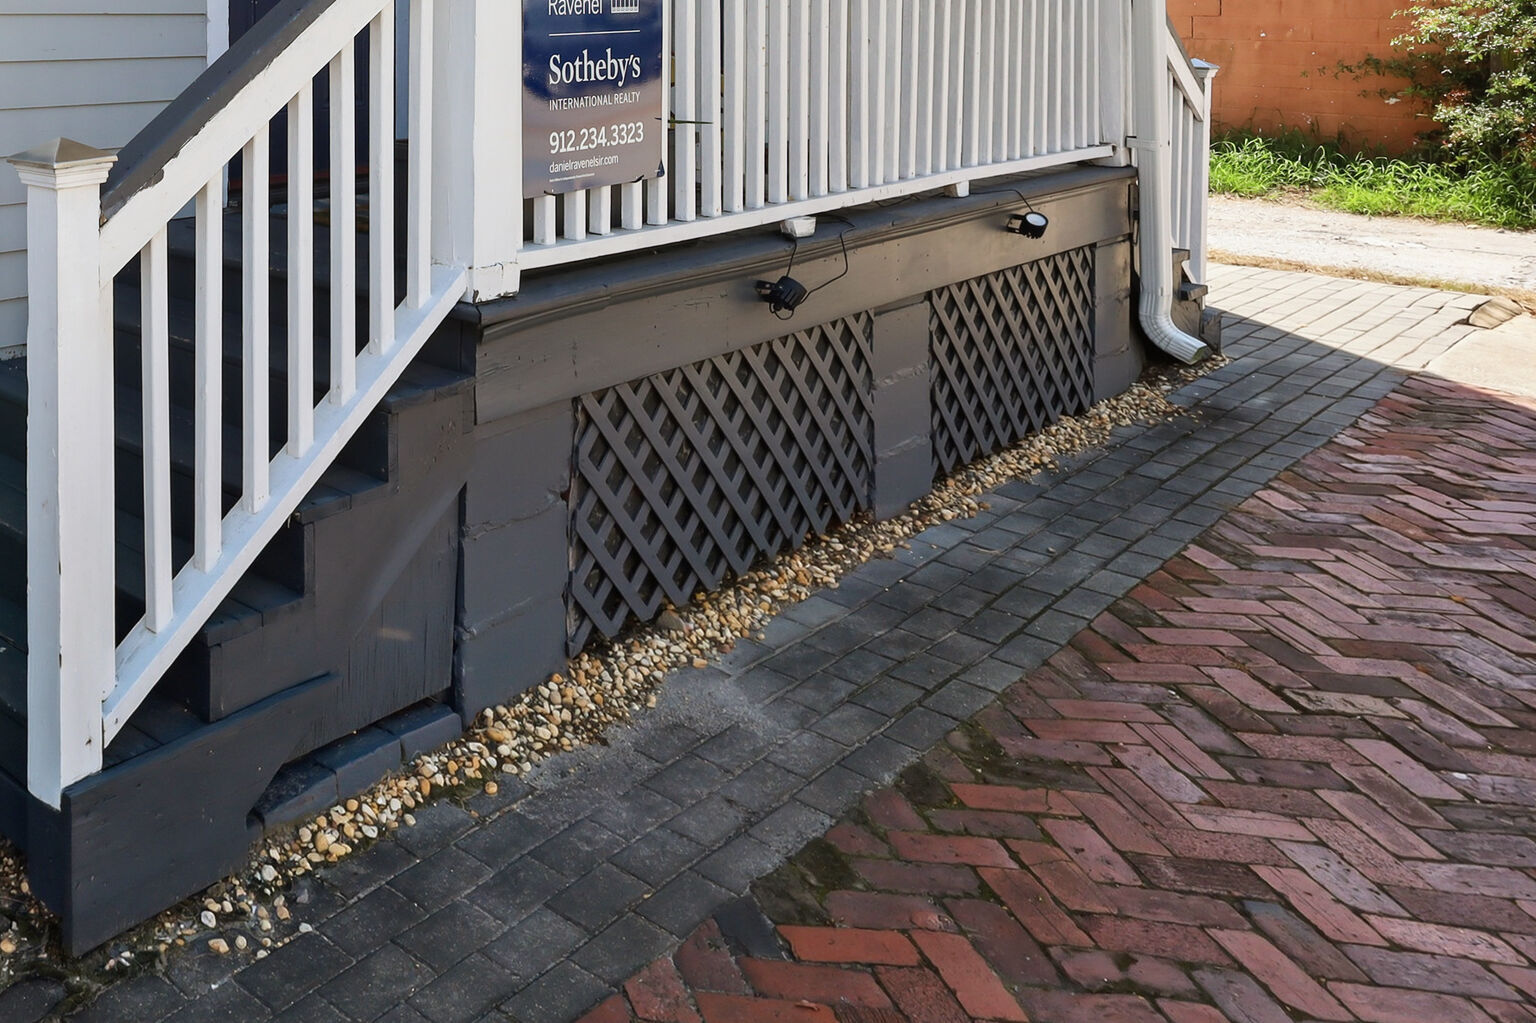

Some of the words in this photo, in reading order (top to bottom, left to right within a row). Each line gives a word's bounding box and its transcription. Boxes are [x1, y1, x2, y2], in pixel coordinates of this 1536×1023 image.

[549, 47, 641, 87] Sotheby's
[549, 95, 613, 111] INTERNATIONAL
[614, 91, 641, 105] REALTY
[549, 121, 644, 154] 912.234.3323
[549, 155, 619, 173] danielravenelsir.com
